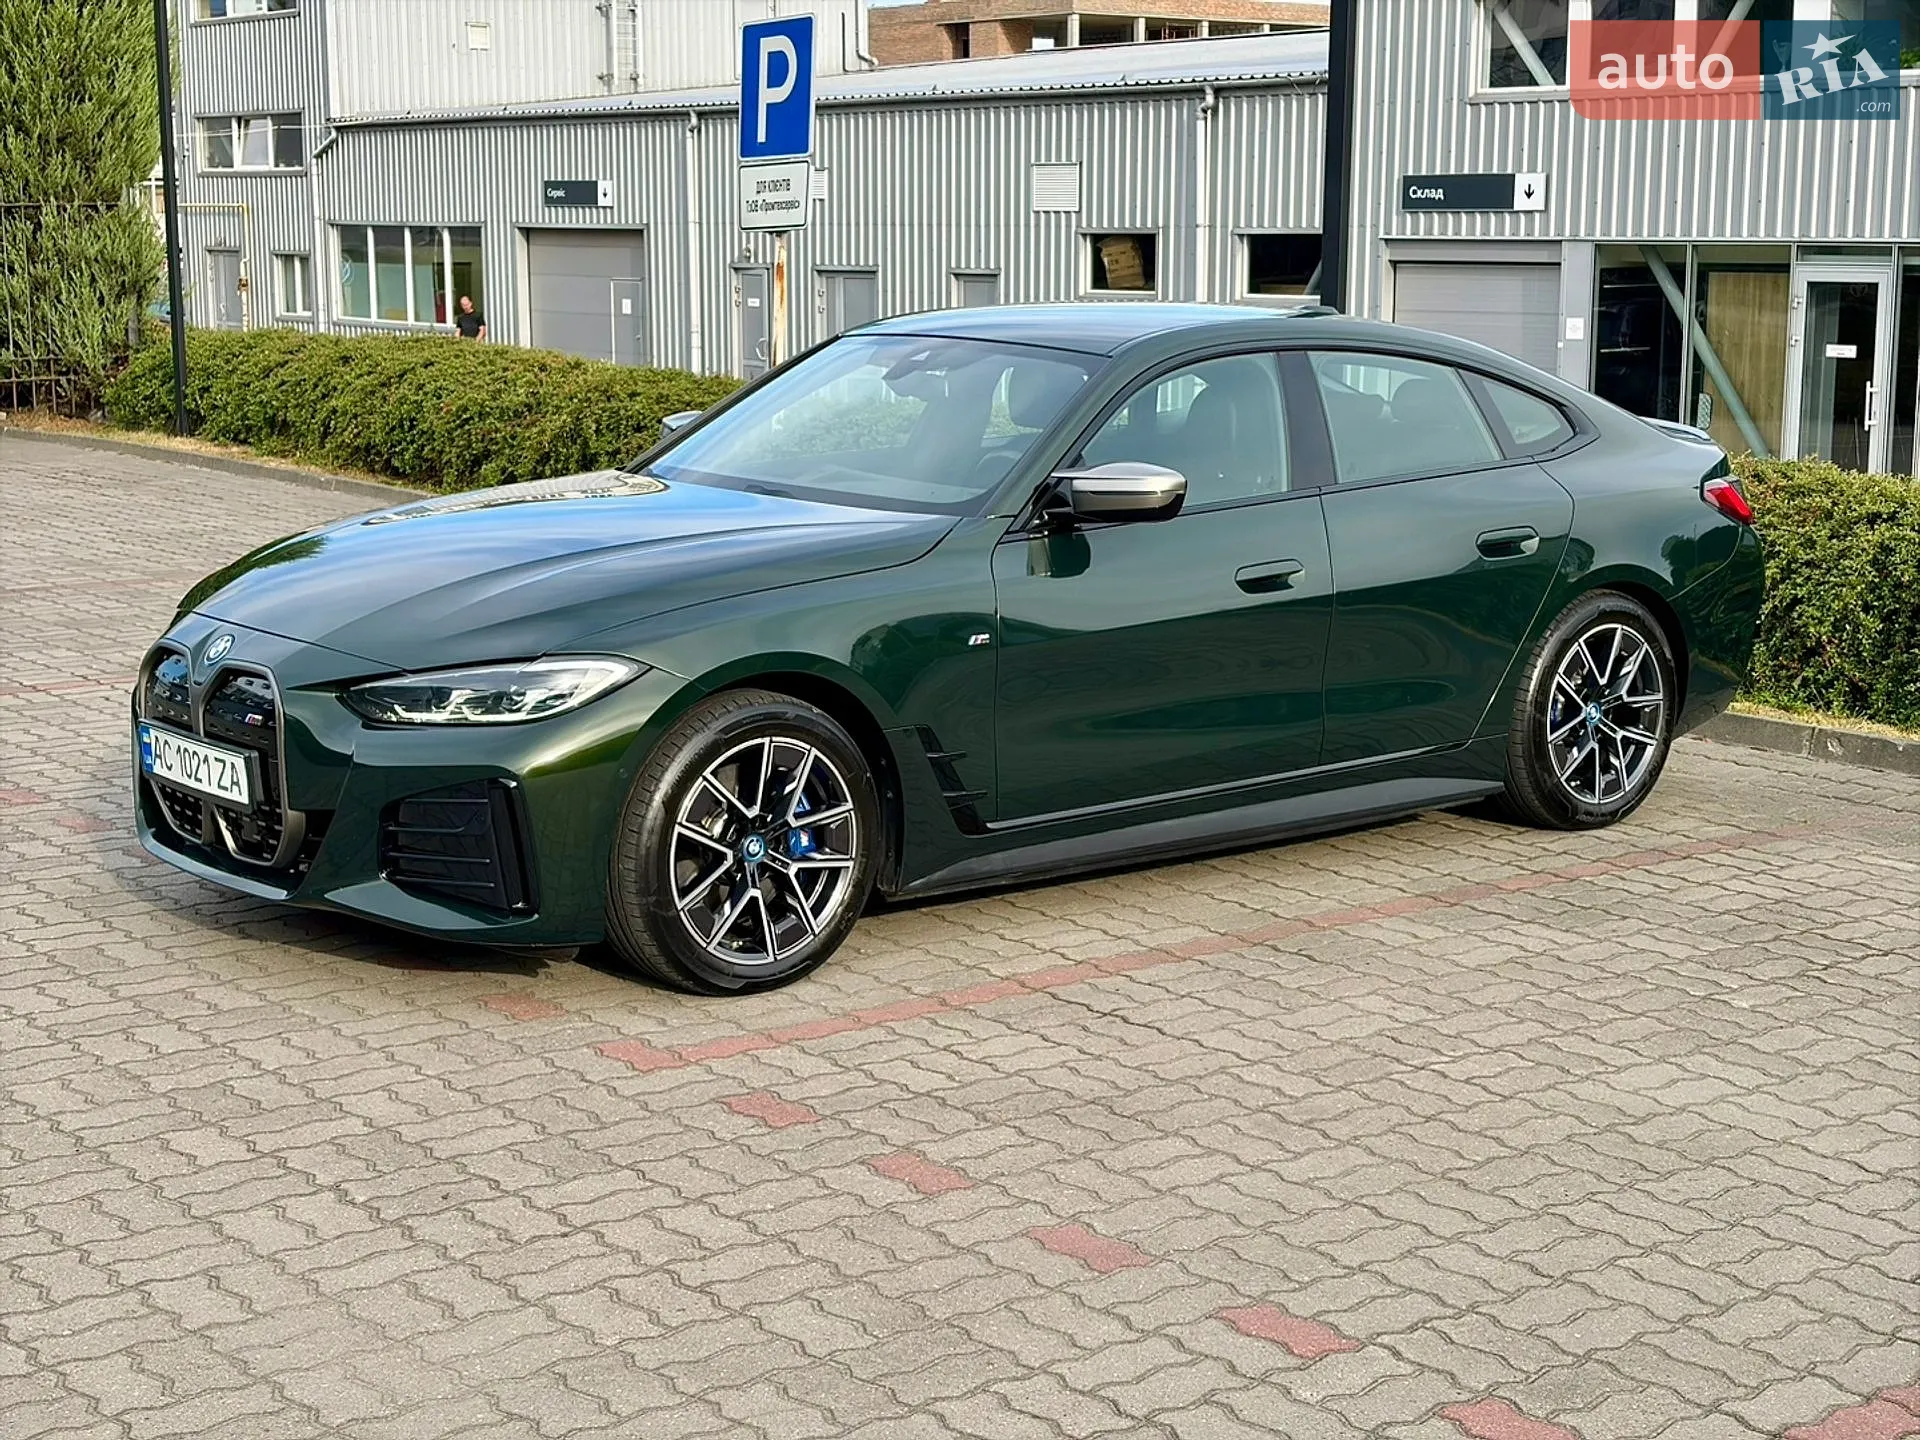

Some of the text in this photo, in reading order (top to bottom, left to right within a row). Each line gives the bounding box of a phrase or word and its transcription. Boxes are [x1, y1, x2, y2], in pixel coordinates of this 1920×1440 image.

[757, 35, 798, 143] P
[1409, 186, 1444, 200] Склад
[153, 734, 243, 797] AC 1021 ZA
